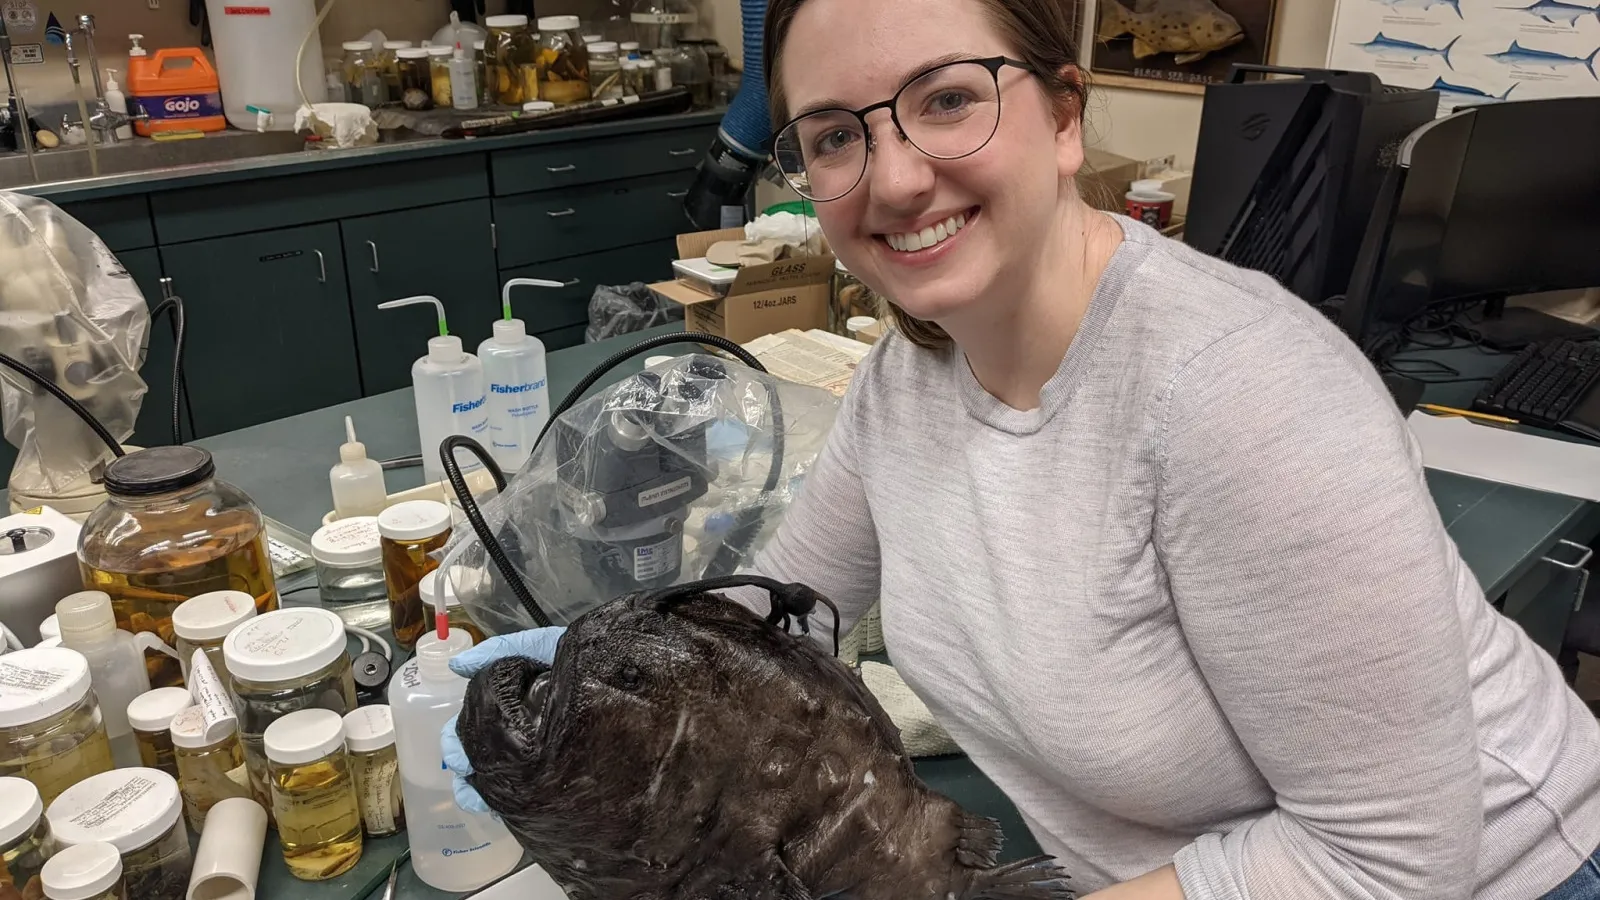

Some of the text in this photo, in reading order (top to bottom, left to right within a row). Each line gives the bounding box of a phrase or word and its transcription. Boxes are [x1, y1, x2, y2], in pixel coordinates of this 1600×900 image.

[1134, 67, 1213, 84] BLACK SEA BASS
[771, 262, 807, 276] GLASS
